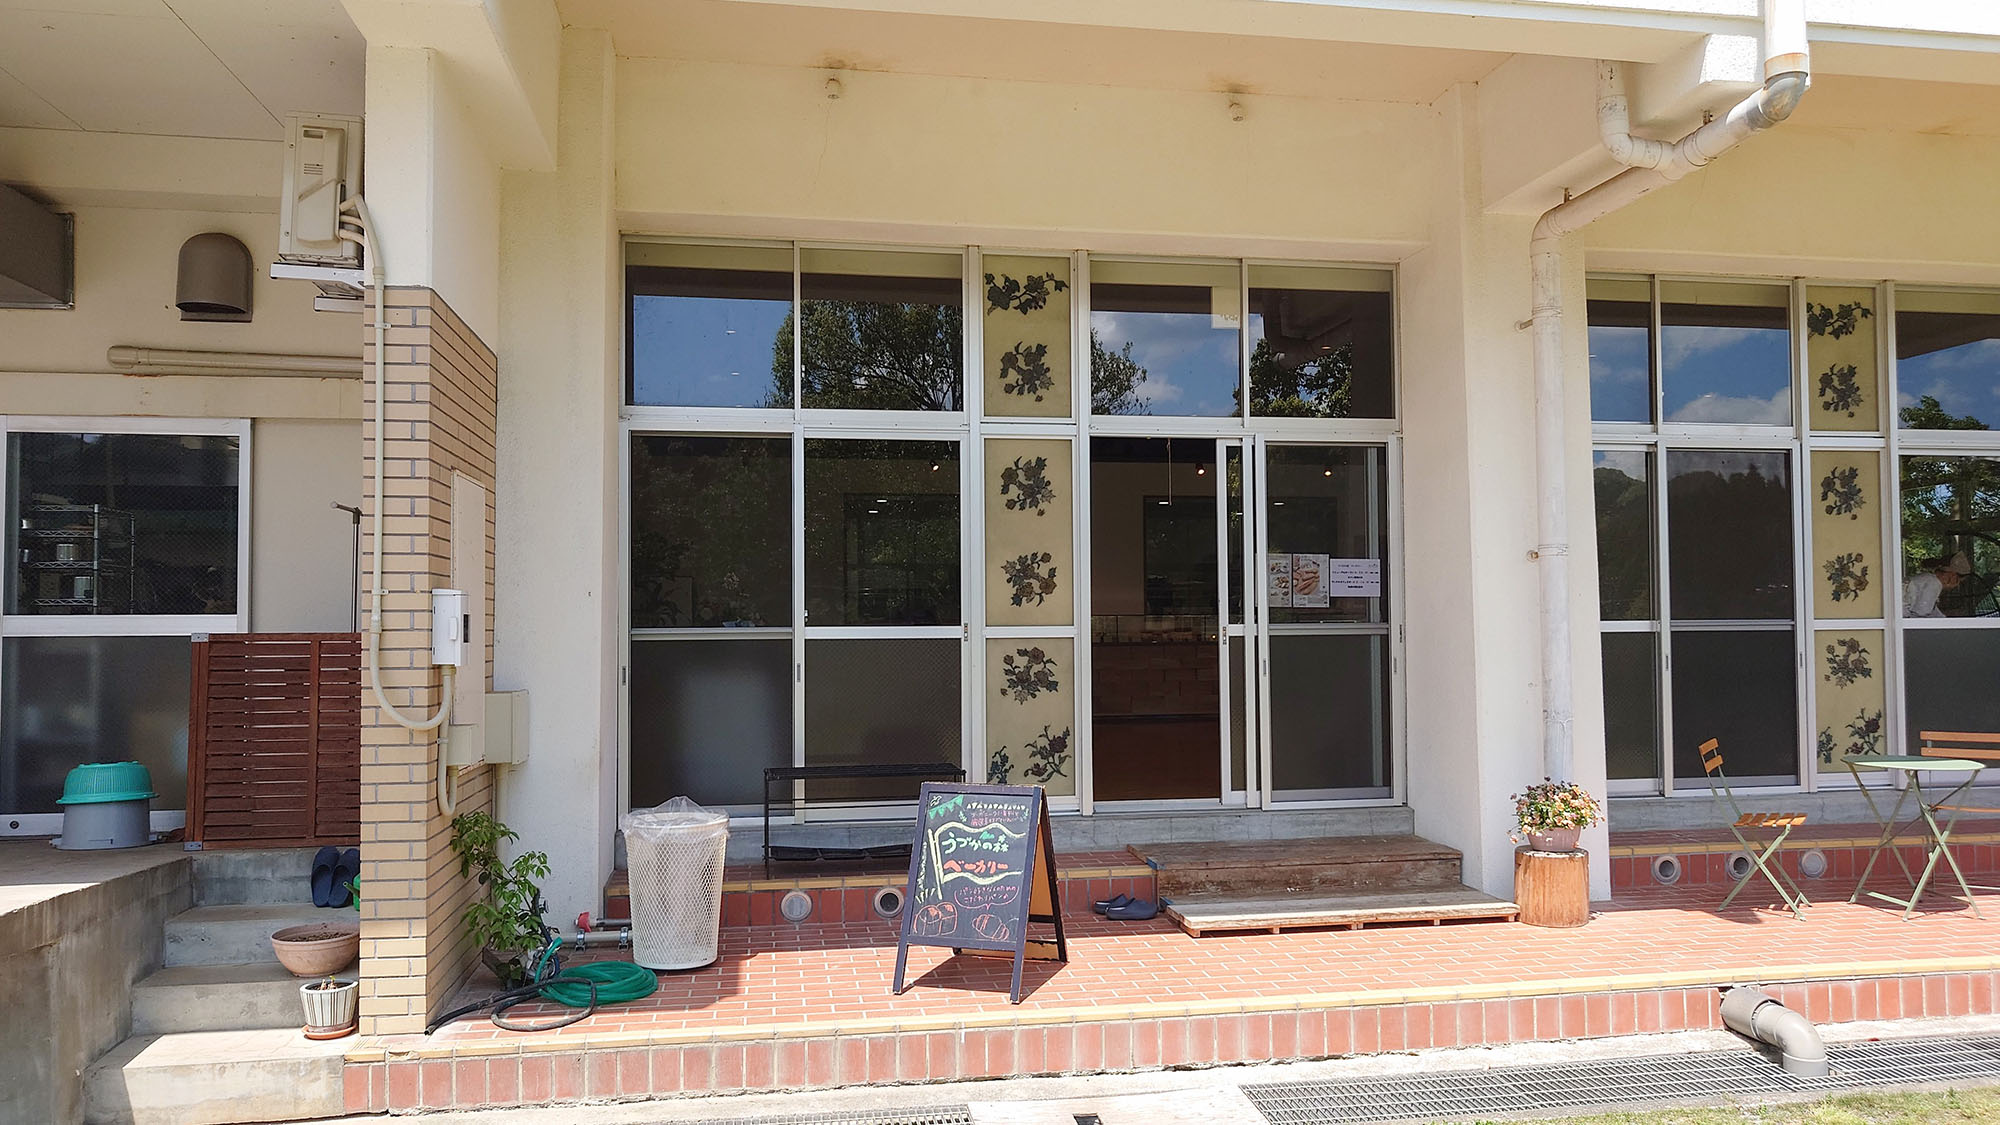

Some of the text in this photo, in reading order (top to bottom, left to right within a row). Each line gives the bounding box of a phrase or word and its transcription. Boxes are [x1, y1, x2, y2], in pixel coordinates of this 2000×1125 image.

[941, 832, 1009, 854] うづかの森
[943, 859, 1009, 874] ベーカリー
